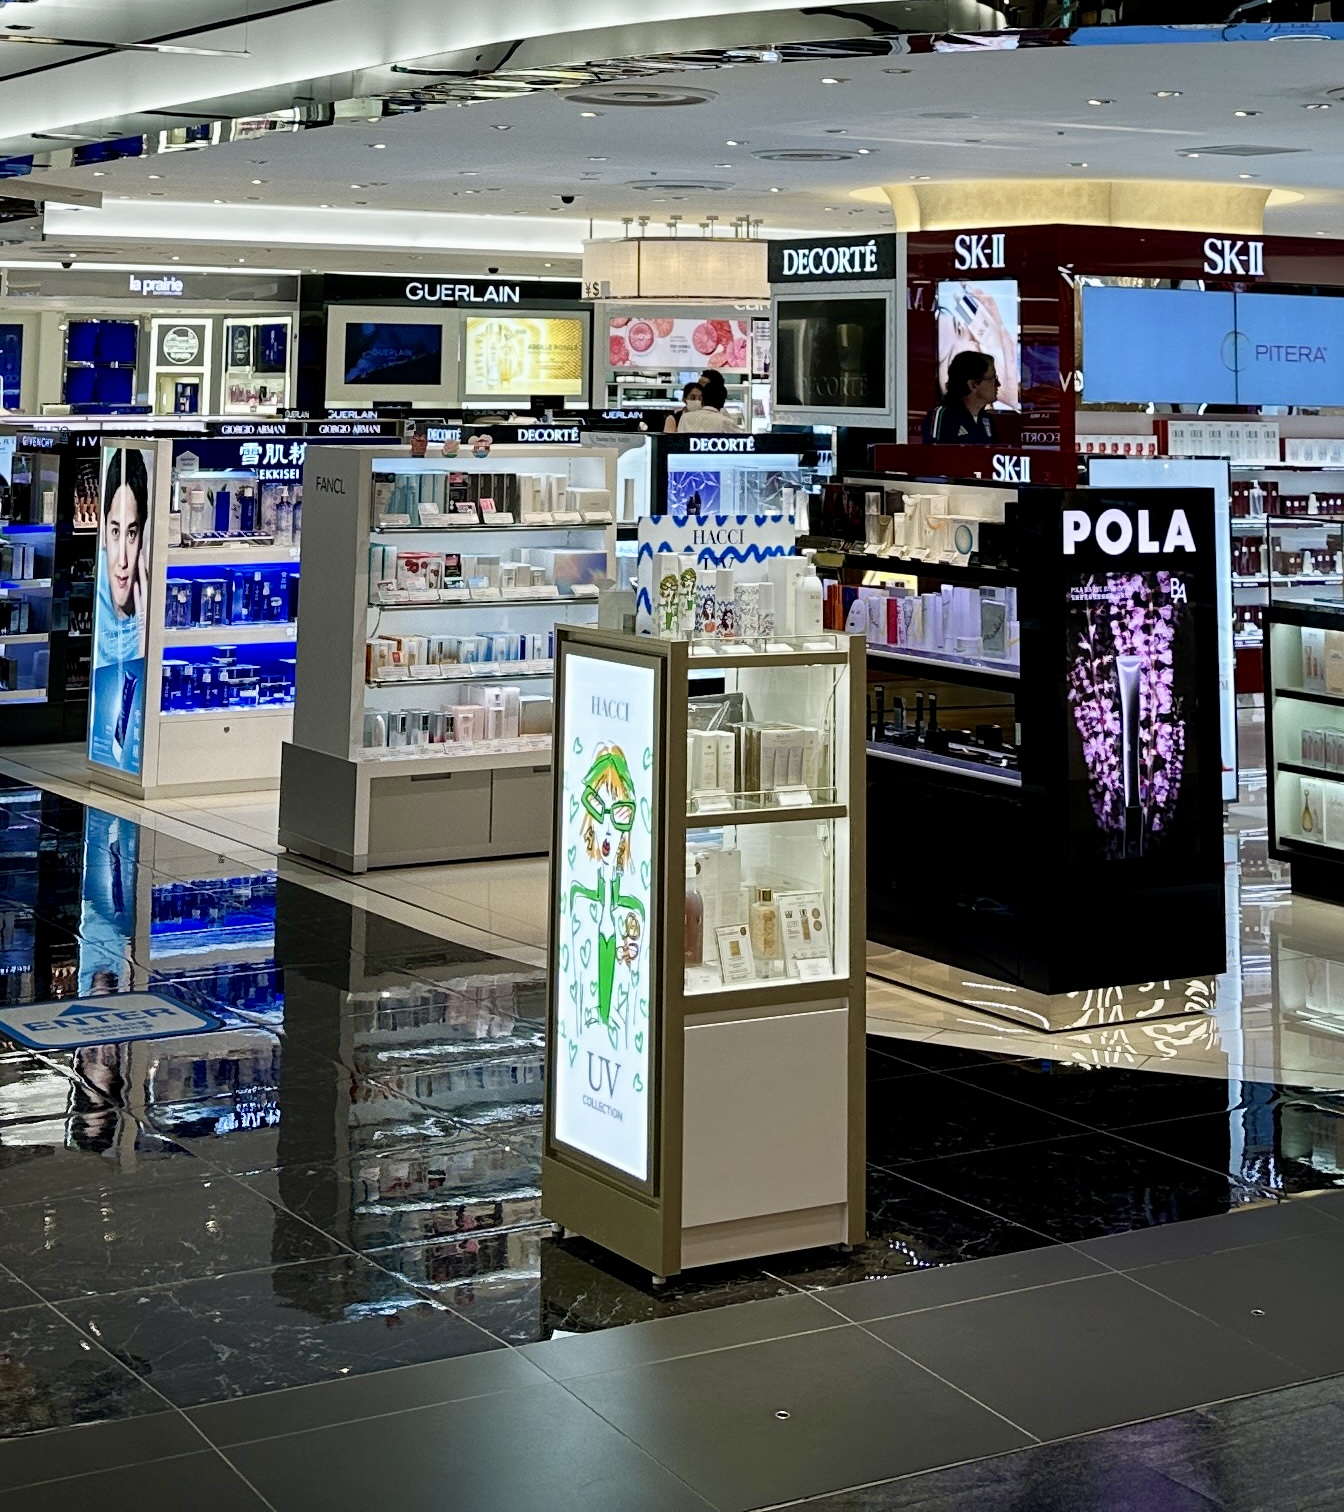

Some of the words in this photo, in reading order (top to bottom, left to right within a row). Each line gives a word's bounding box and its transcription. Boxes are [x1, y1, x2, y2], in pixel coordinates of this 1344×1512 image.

[783, 240, 877, 276] DECORTÉ
[955, 234, 1005, 270] SK-II
[1203, 238, 1264, 275] SK-II
[129, 275, 142, 291] la
[143, 276, 184, 295] prairie
[406, 282, 520, 303] GUERLAIN
[518, 427, 579, 442] DECORTÉ
[690, 437, 755, 452] DECORTÉ
[992, 454, 1030, 483] SK-II
[316, 476, 346, 494] FANCL
[693, 529, 745, 545] HACCI
[1062, 508, 1196, 555] POLA
[591, 695, 629, 723] HACCI
[22, 1007, 178, 1032] ENTER
[587, 1050, 622, 1098] UV
[582, 1094, 623, 1121] COLLECTION
